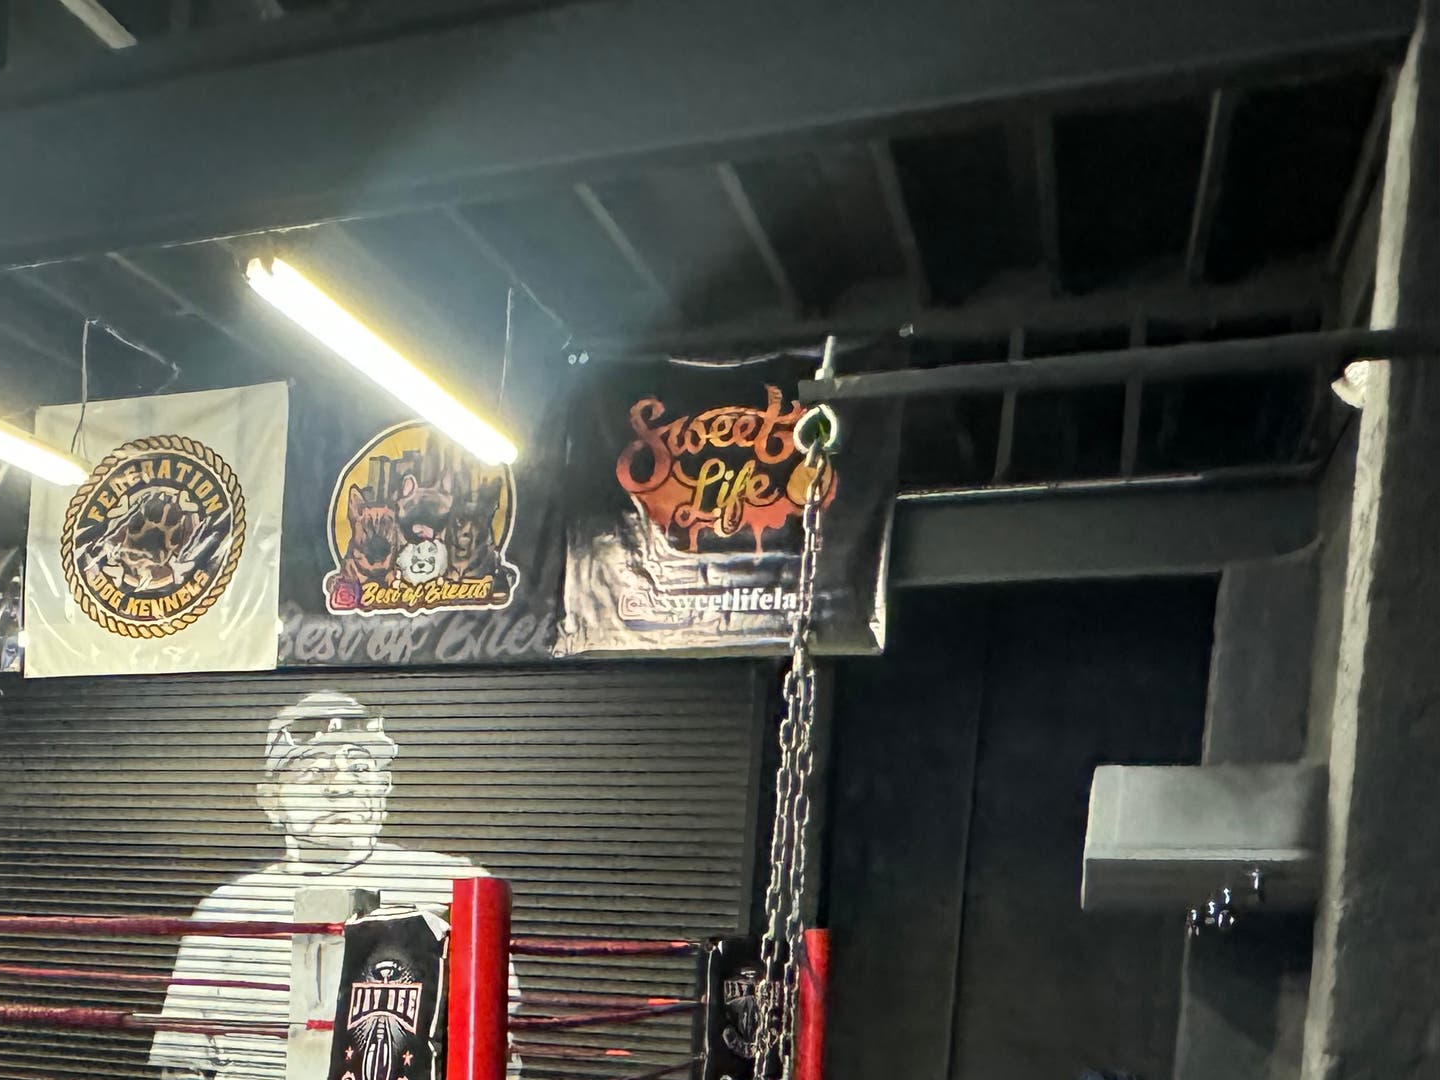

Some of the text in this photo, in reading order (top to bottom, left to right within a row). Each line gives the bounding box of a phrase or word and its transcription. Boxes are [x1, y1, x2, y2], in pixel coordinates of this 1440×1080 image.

[616, 383, 807, 494] Sweet
[87, 458, 224, 523] FEDERATION
[672, 457, 782, 537] Life
[87, 569, 209, 619] DOG KENNELS
[401, 584, 424, 607] of
